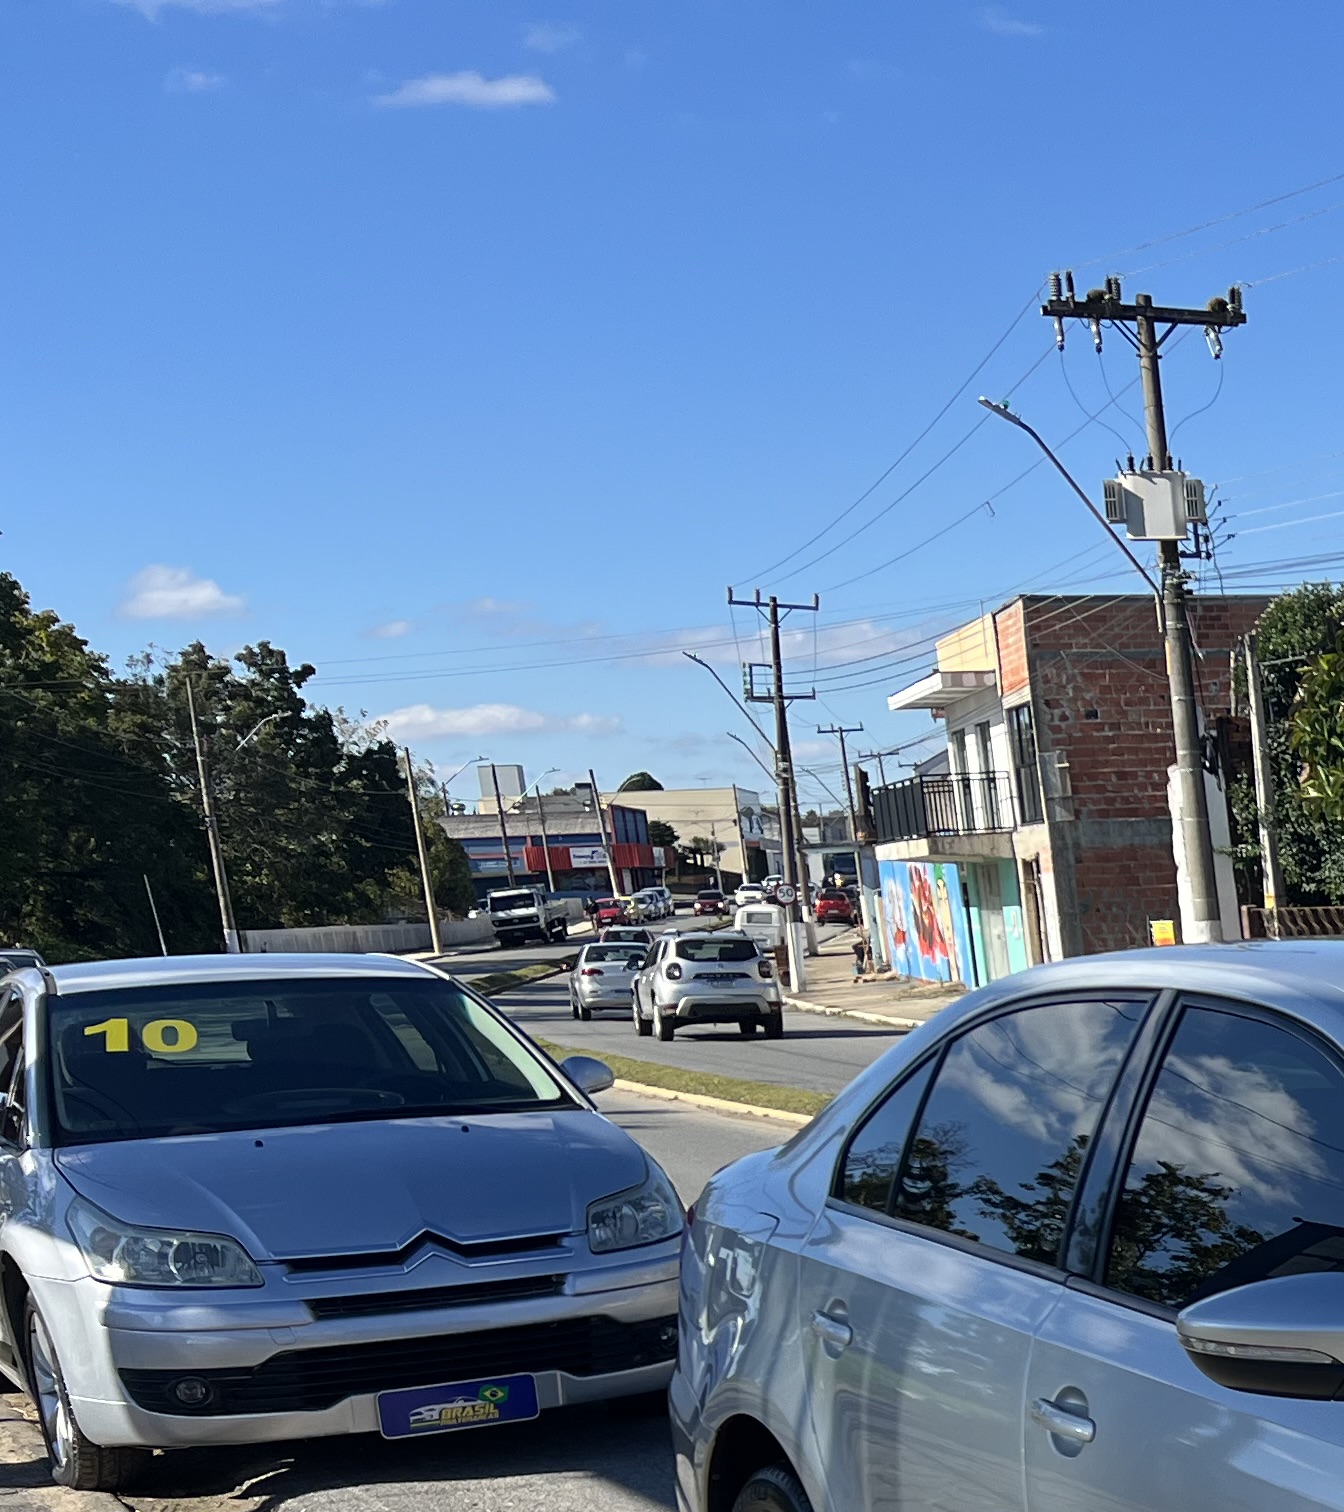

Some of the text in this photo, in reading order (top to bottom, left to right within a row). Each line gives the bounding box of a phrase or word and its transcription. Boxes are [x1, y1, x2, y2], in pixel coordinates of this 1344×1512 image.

[779, 888, 793, 898] 50
[84, 1017, 198, 1053] 10
[441, 1403, 498, 1420] BRASIL
